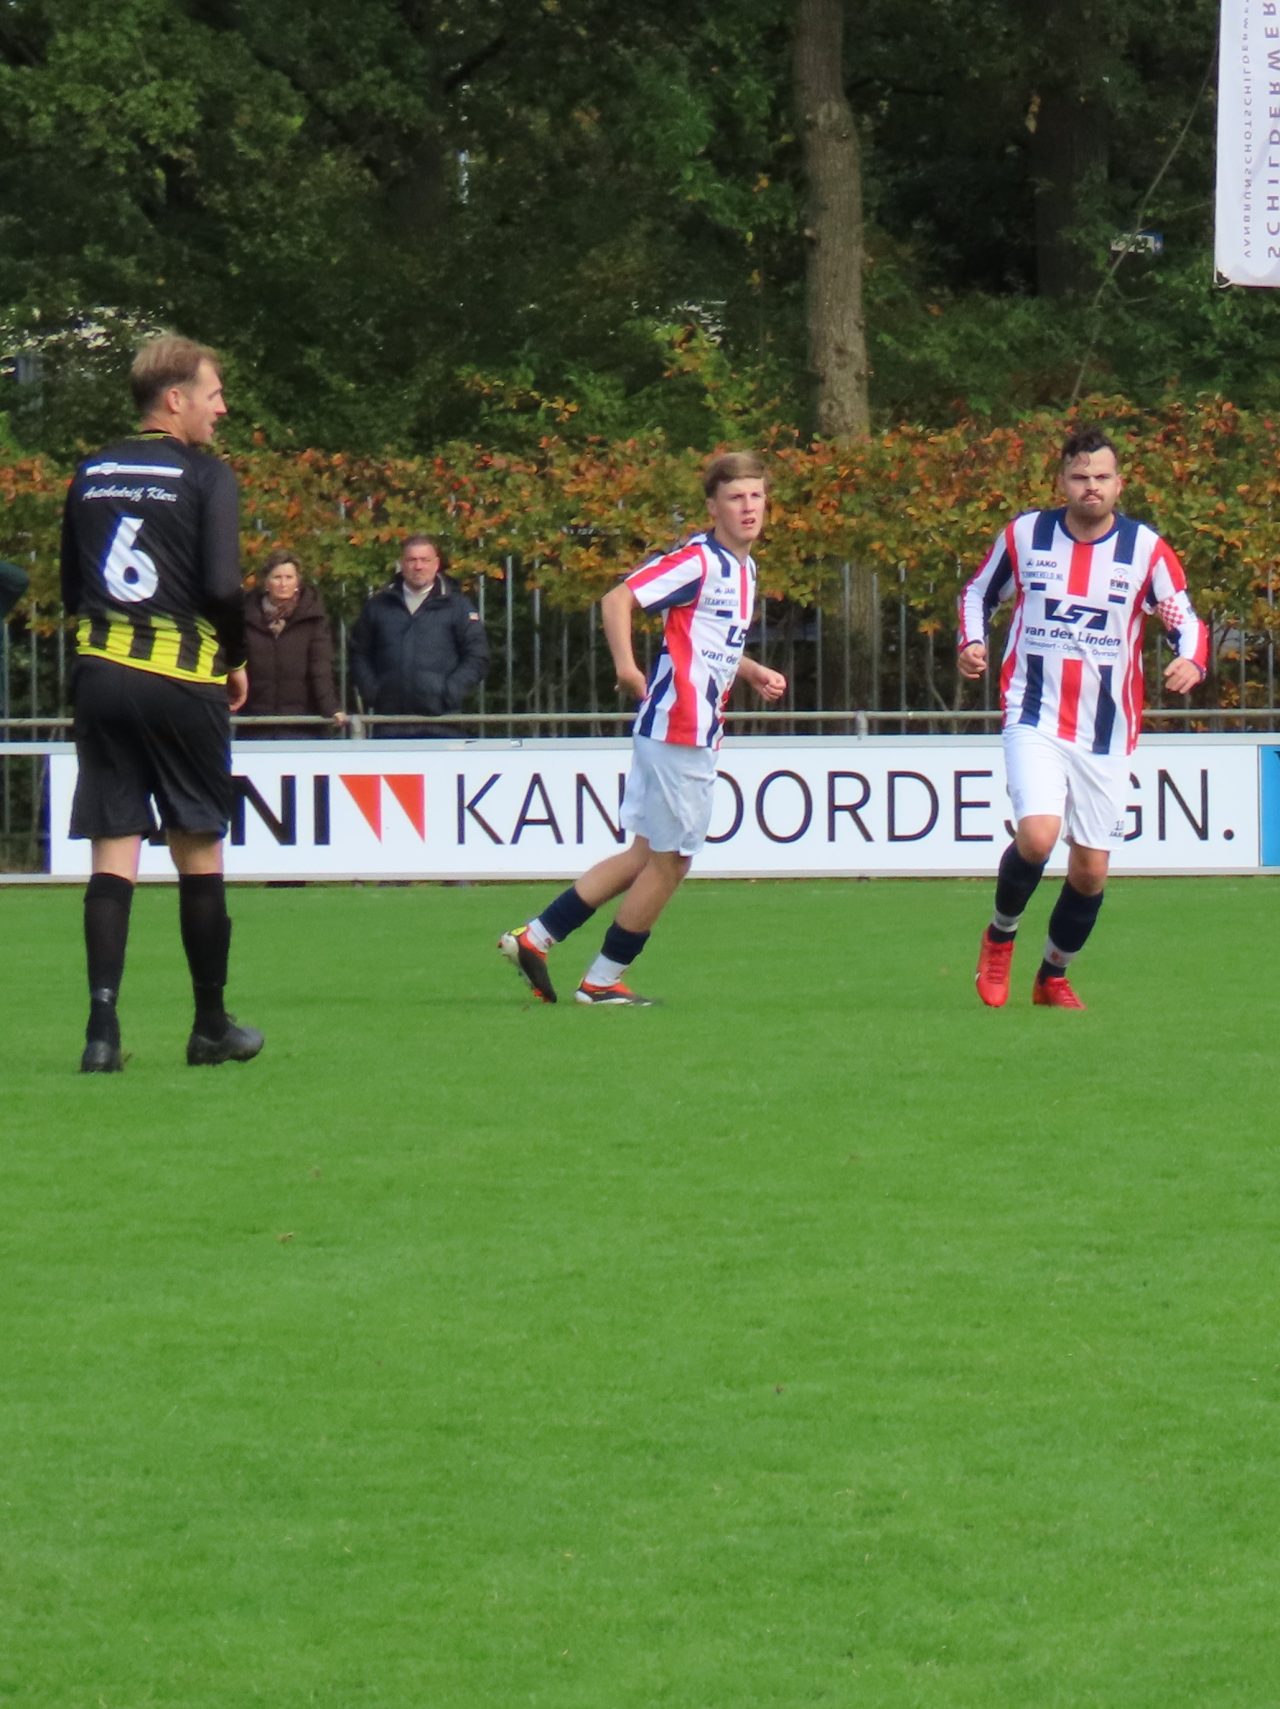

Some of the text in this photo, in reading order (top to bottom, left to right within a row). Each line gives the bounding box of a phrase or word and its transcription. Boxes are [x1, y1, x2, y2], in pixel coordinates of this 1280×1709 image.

[103, 516, 159, 602] 6
[1025, 626, 1122, 646] van der Linden
